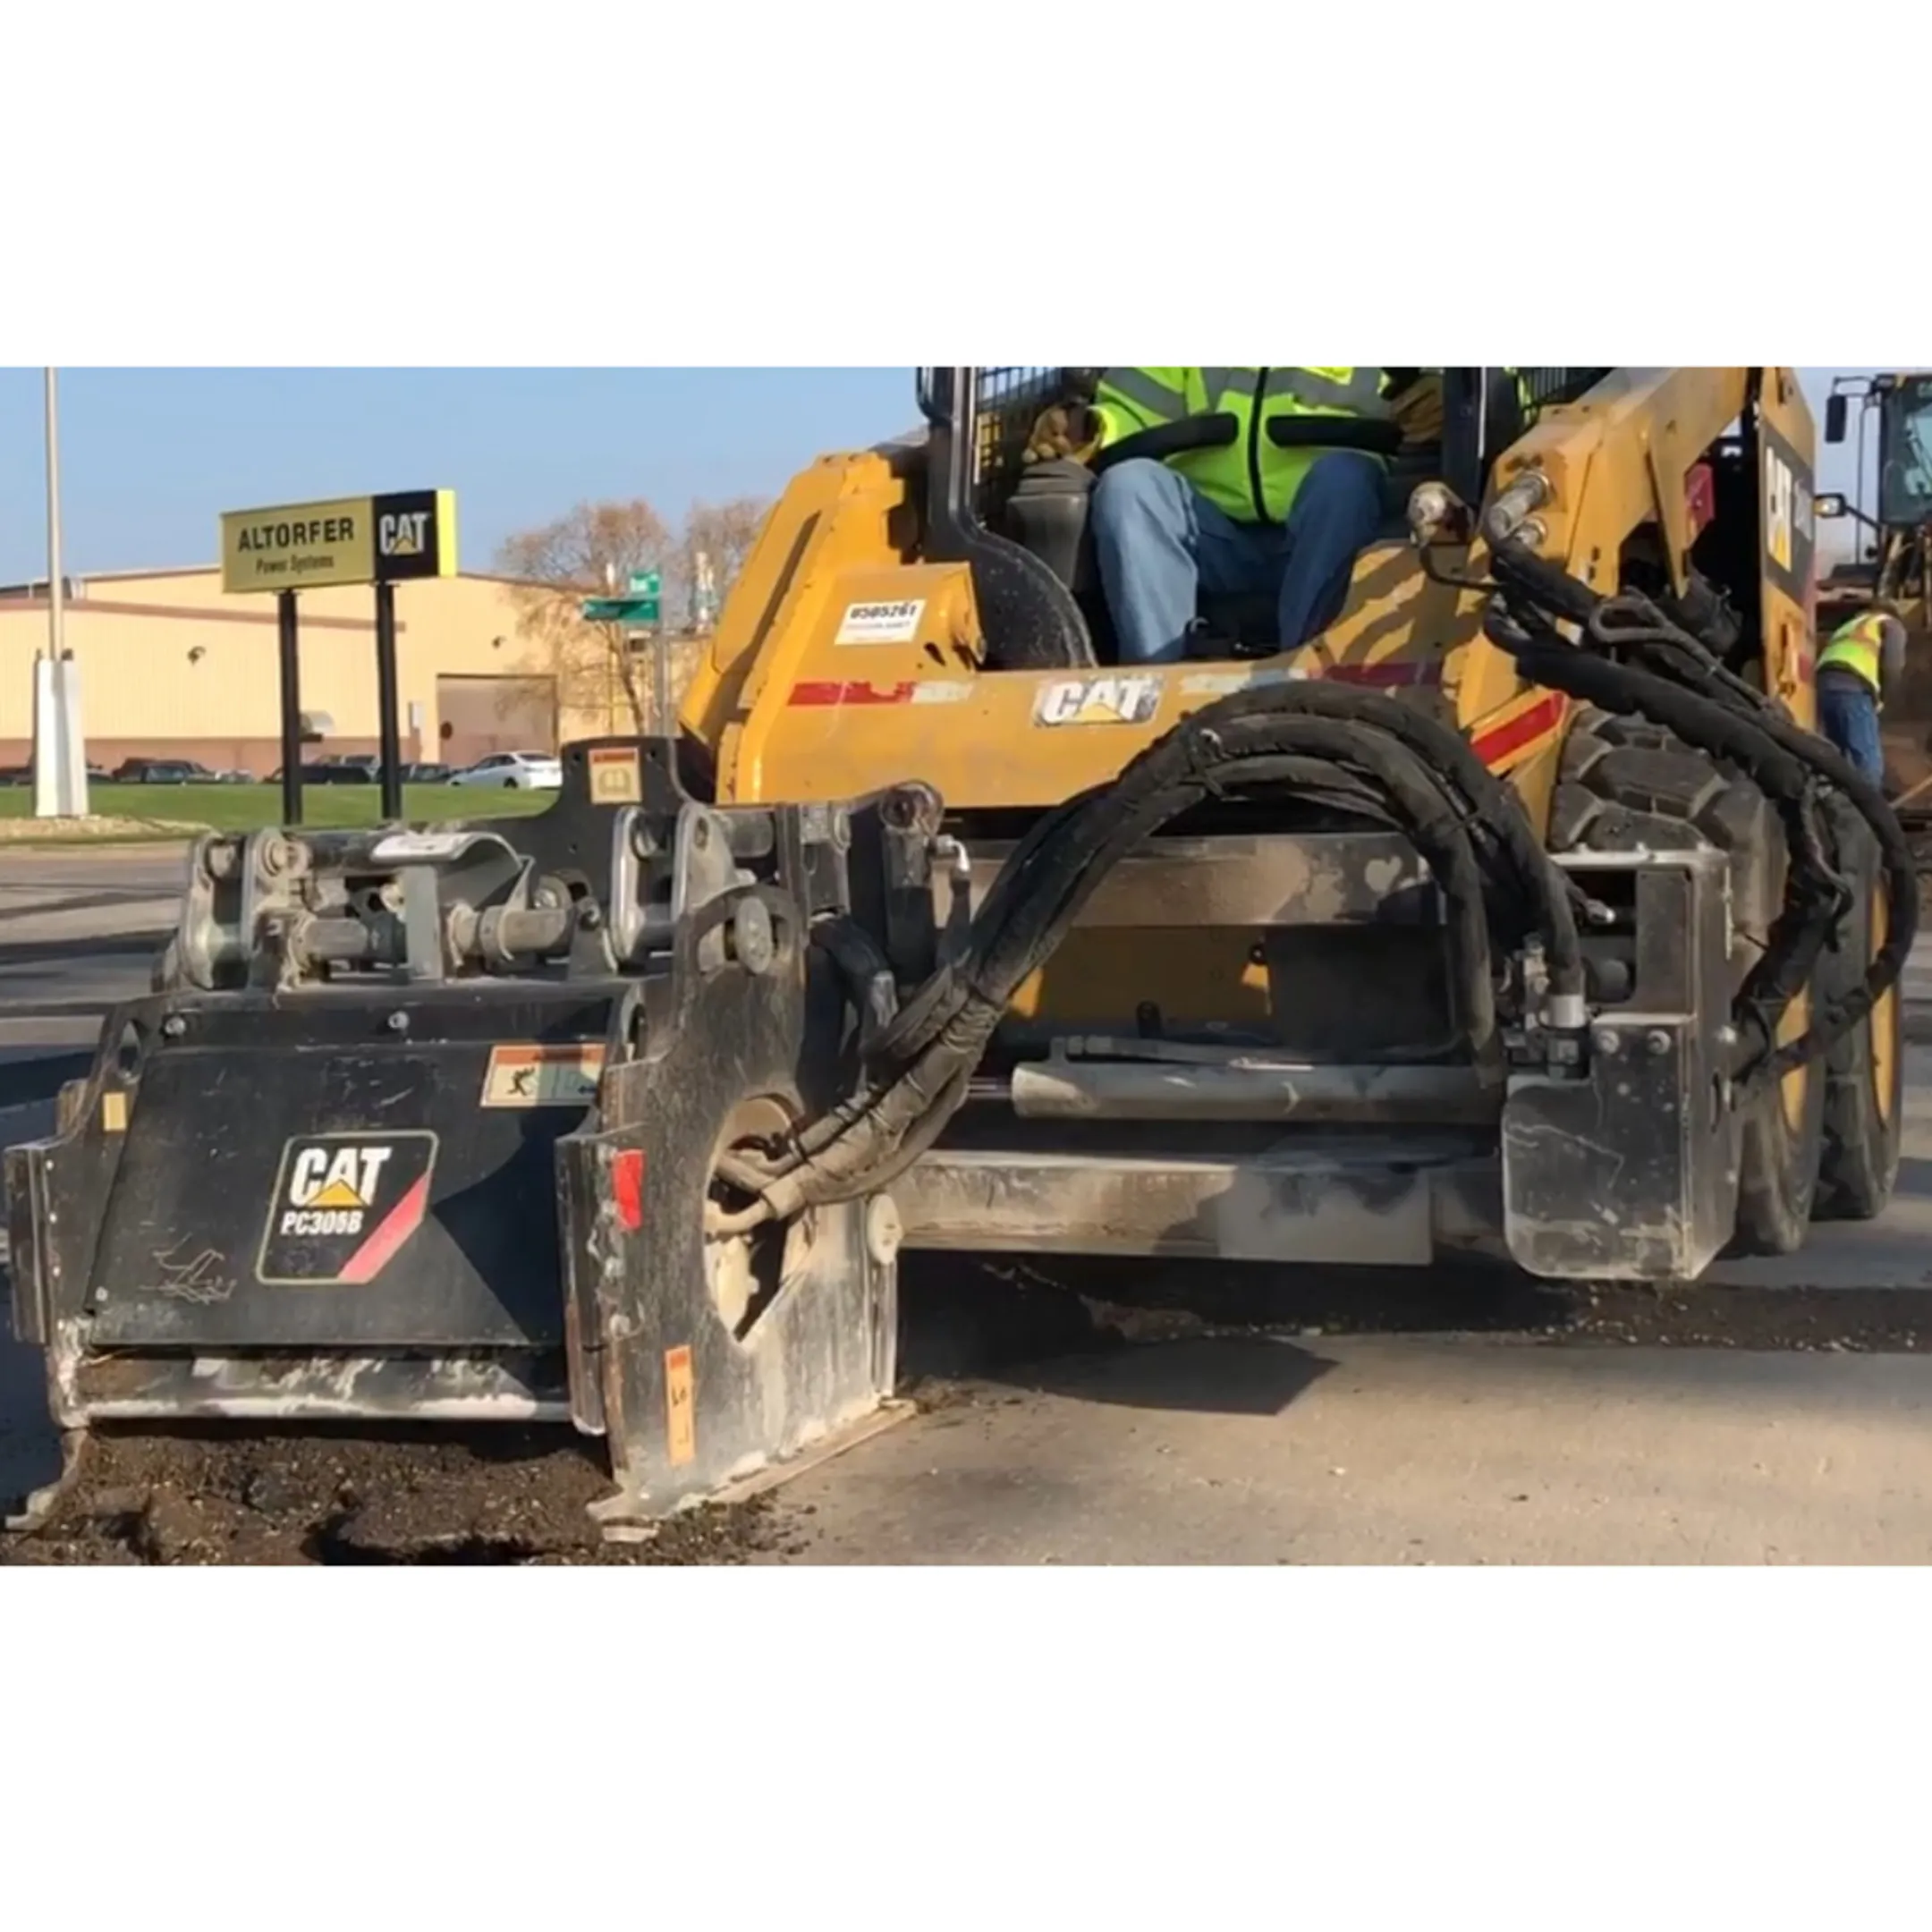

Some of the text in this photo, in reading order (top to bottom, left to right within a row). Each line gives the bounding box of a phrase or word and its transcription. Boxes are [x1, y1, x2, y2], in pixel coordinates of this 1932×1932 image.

[238, 517, 355, 552] ALTORFER
[379, 512, 430, 555] CAT
[256, 555, 335, 574] Power Systems
[1043, 679, 1152, 723] CAT
[289, 1146, 393, 1207] CAT
